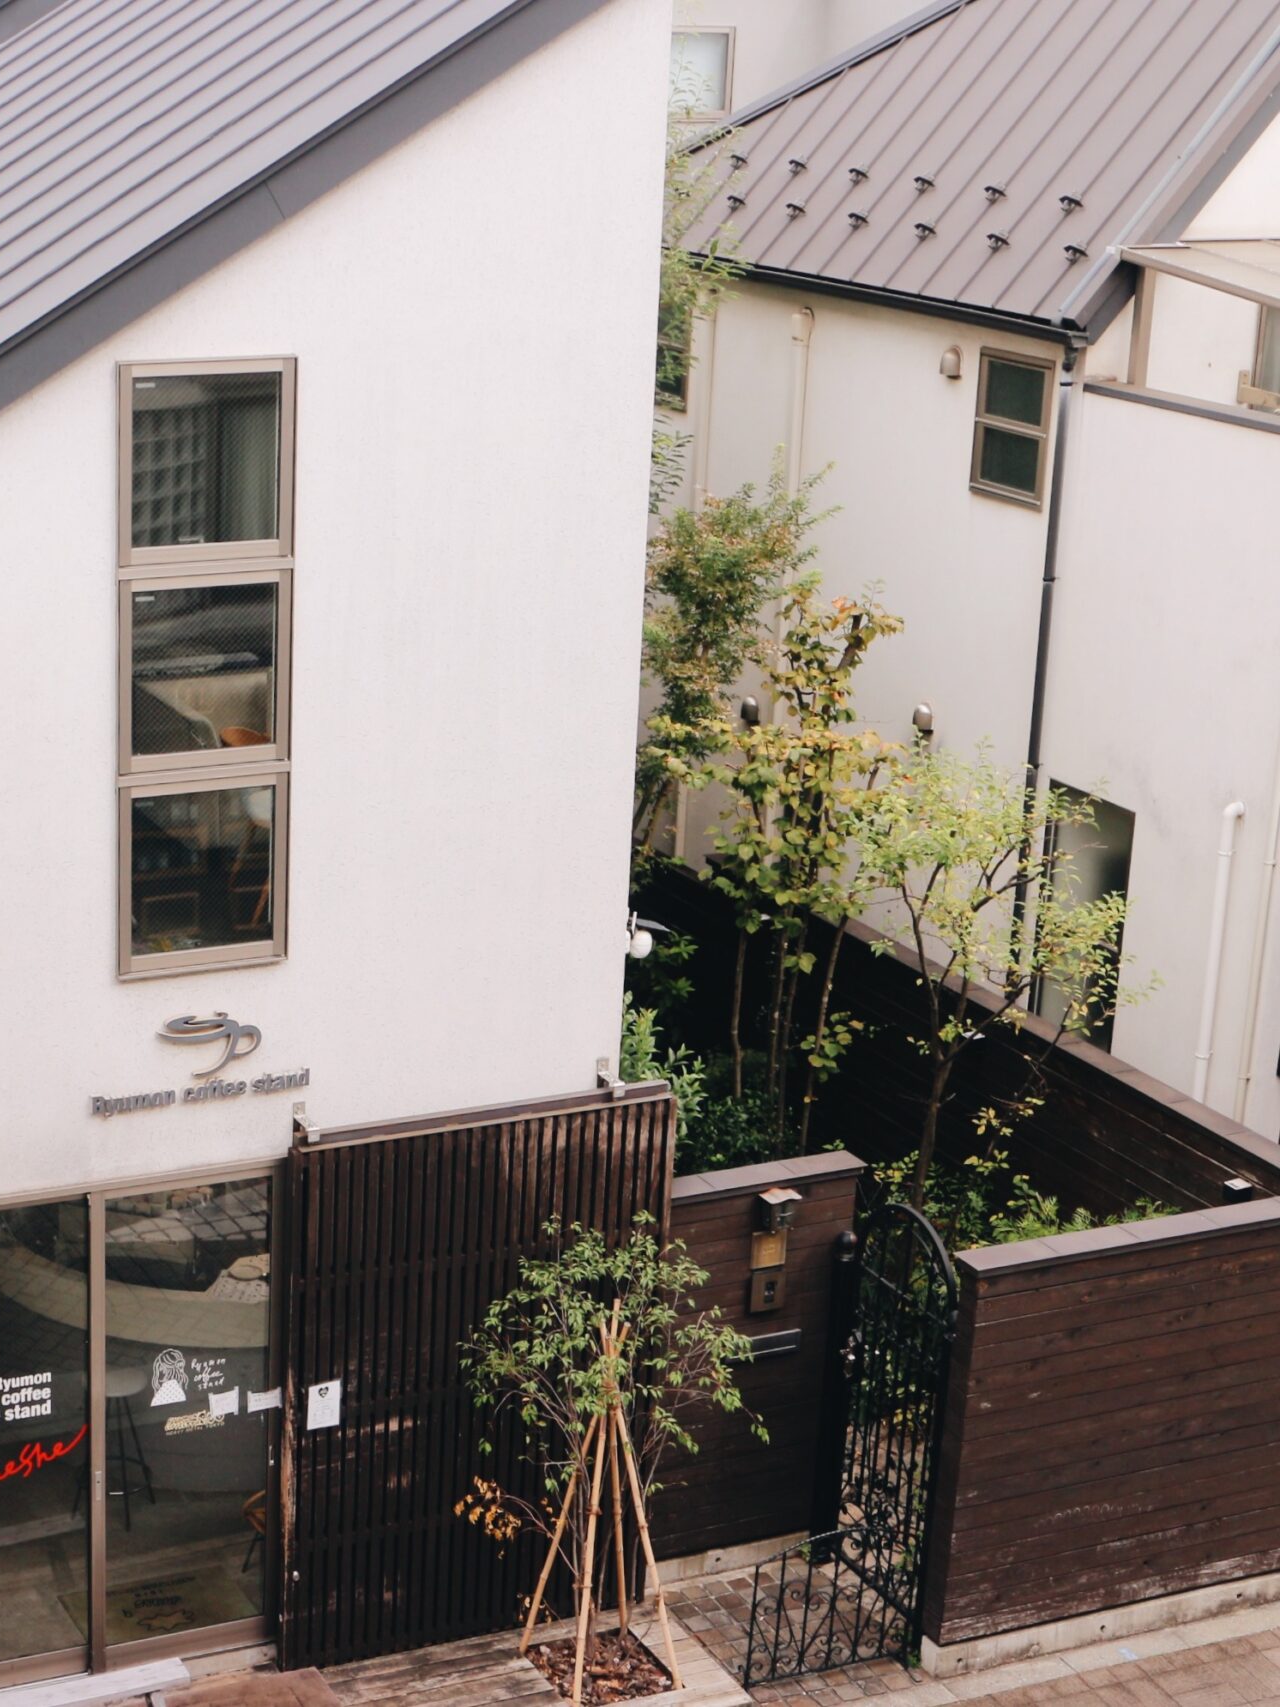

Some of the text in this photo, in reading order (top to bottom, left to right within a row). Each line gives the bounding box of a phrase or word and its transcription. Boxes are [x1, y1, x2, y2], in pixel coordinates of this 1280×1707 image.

[91, 1067, 311, 1117] Ryumon coffee stand
[1, 1387, 52, 1406] coffee
[4, 1399, 52, 1421] stand
